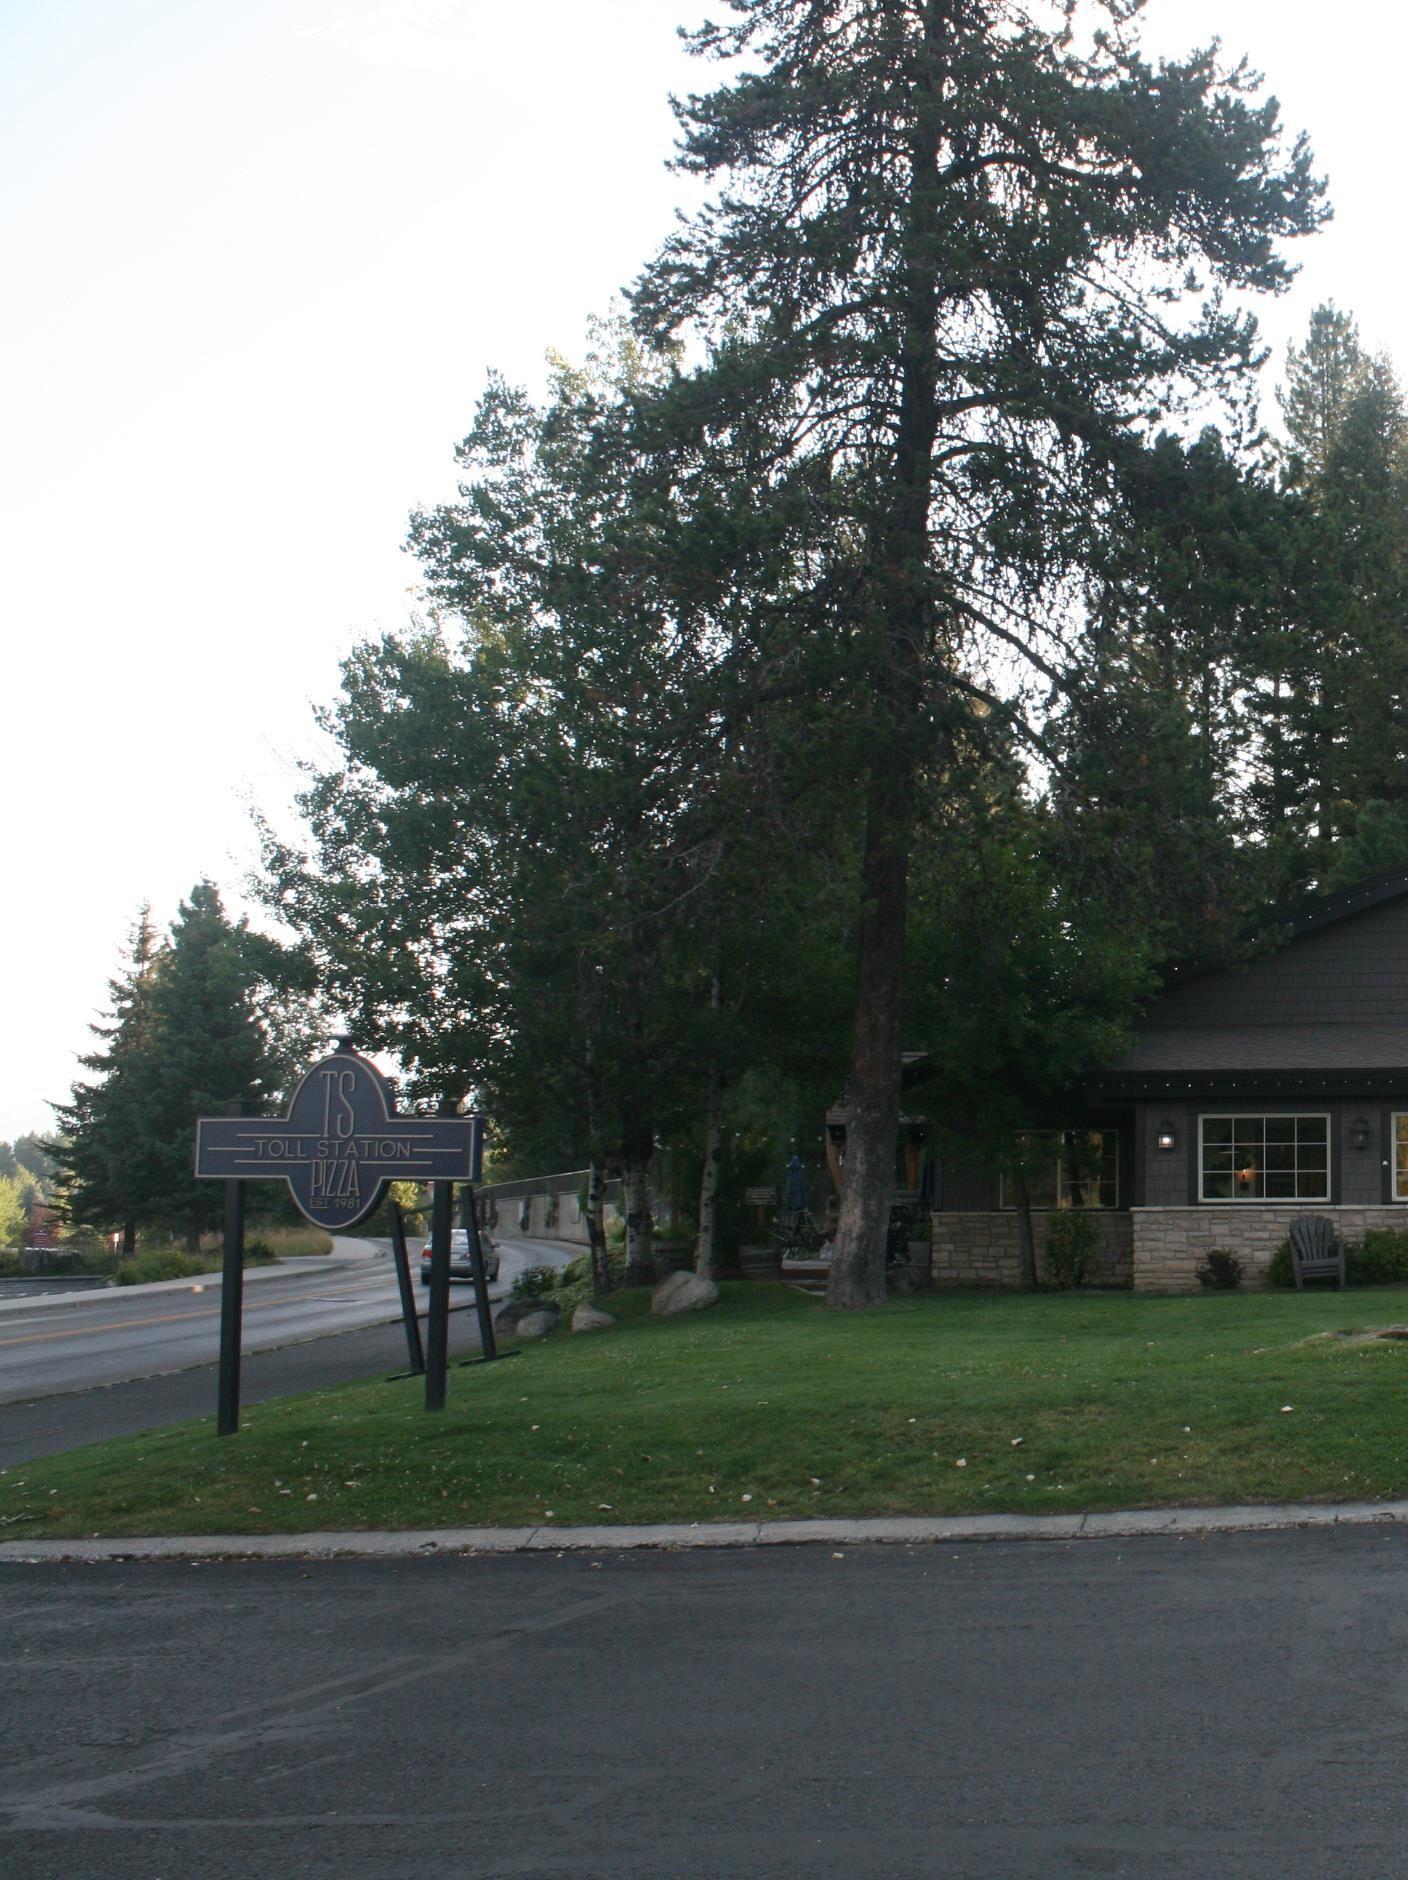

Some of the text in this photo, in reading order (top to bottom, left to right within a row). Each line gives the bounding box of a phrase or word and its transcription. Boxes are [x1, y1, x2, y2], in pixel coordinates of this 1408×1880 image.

[320, 1070, 356, 1138] TS
[255, 1139, 411, 1158] TOLL STATION
[310, 1159, 360, 1197] PIZZA
[336, 1198, 360, 1208] 1981
